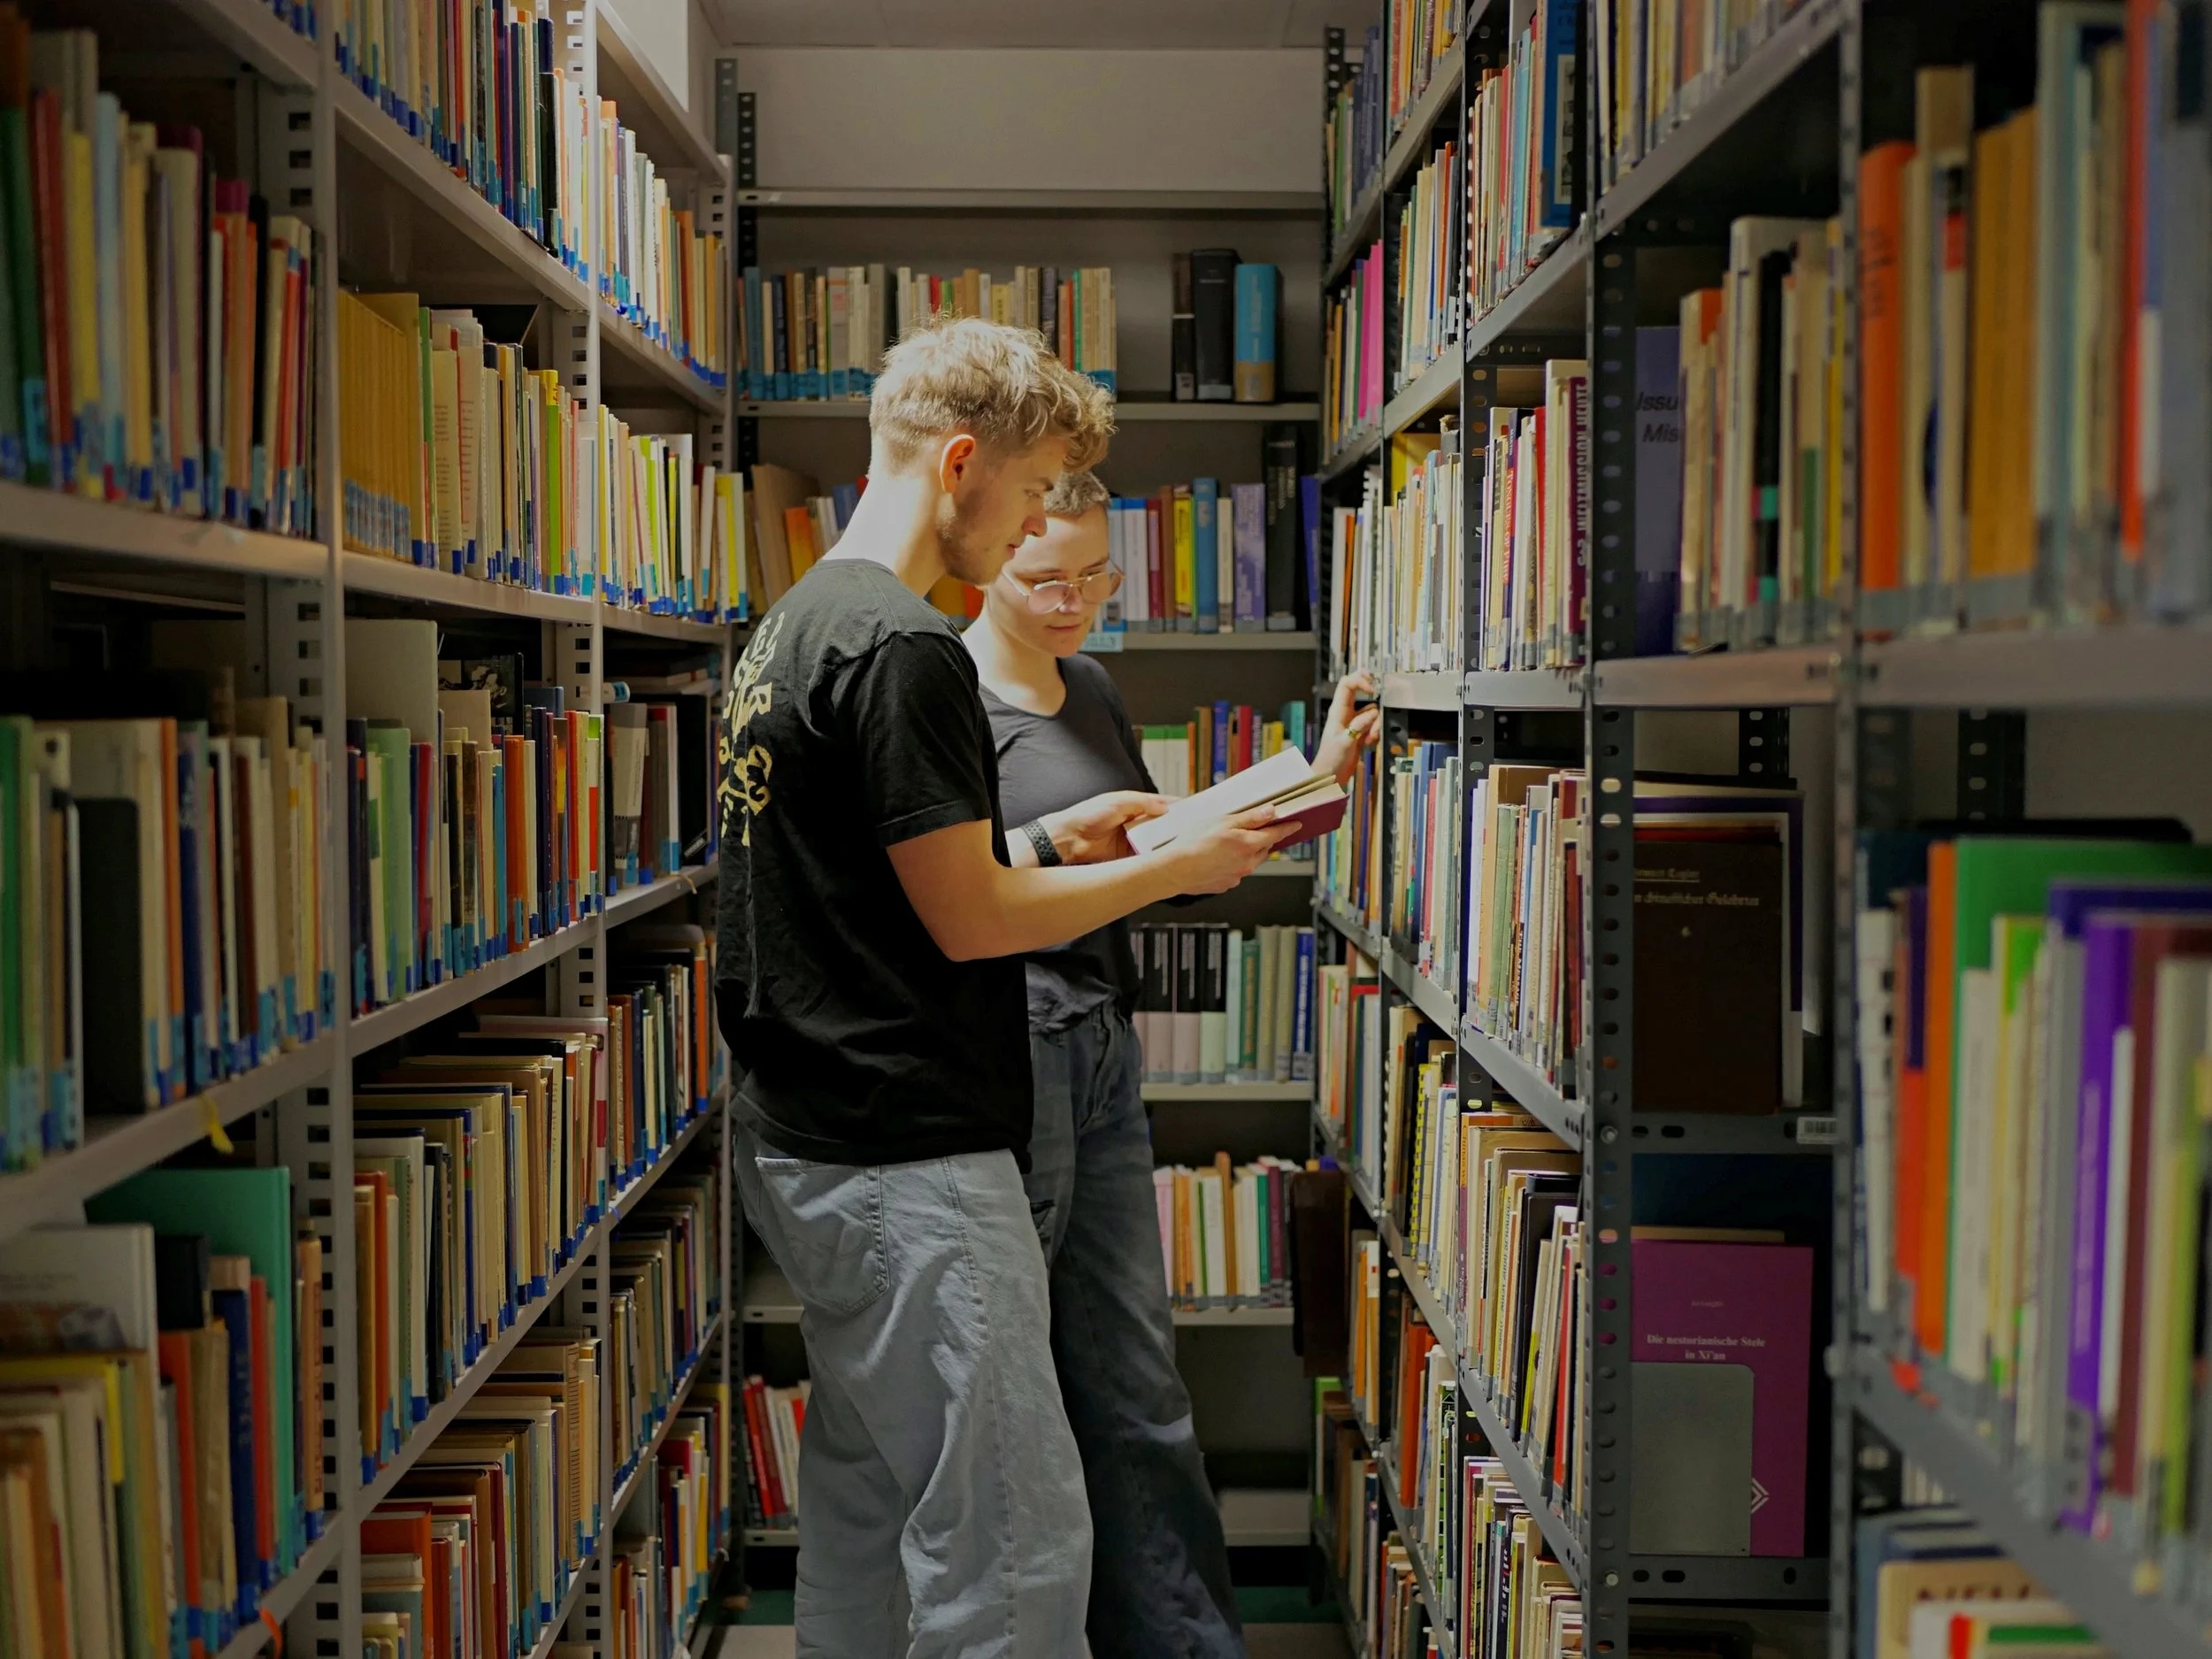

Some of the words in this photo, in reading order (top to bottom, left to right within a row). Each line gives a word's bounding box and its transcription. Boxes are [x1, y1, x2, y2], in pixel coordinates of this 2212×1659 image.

[1636, 391, 1679, 411] Issu
[1504, 531, 1510, 548] OF
[1647, 1333, 1663, 1344] Die
[1666, 1335, 1738, 1346] nestorianische
[1740, 1336, 1765, 1347] Stele
[1685, 1349, 1695, 1360] in
